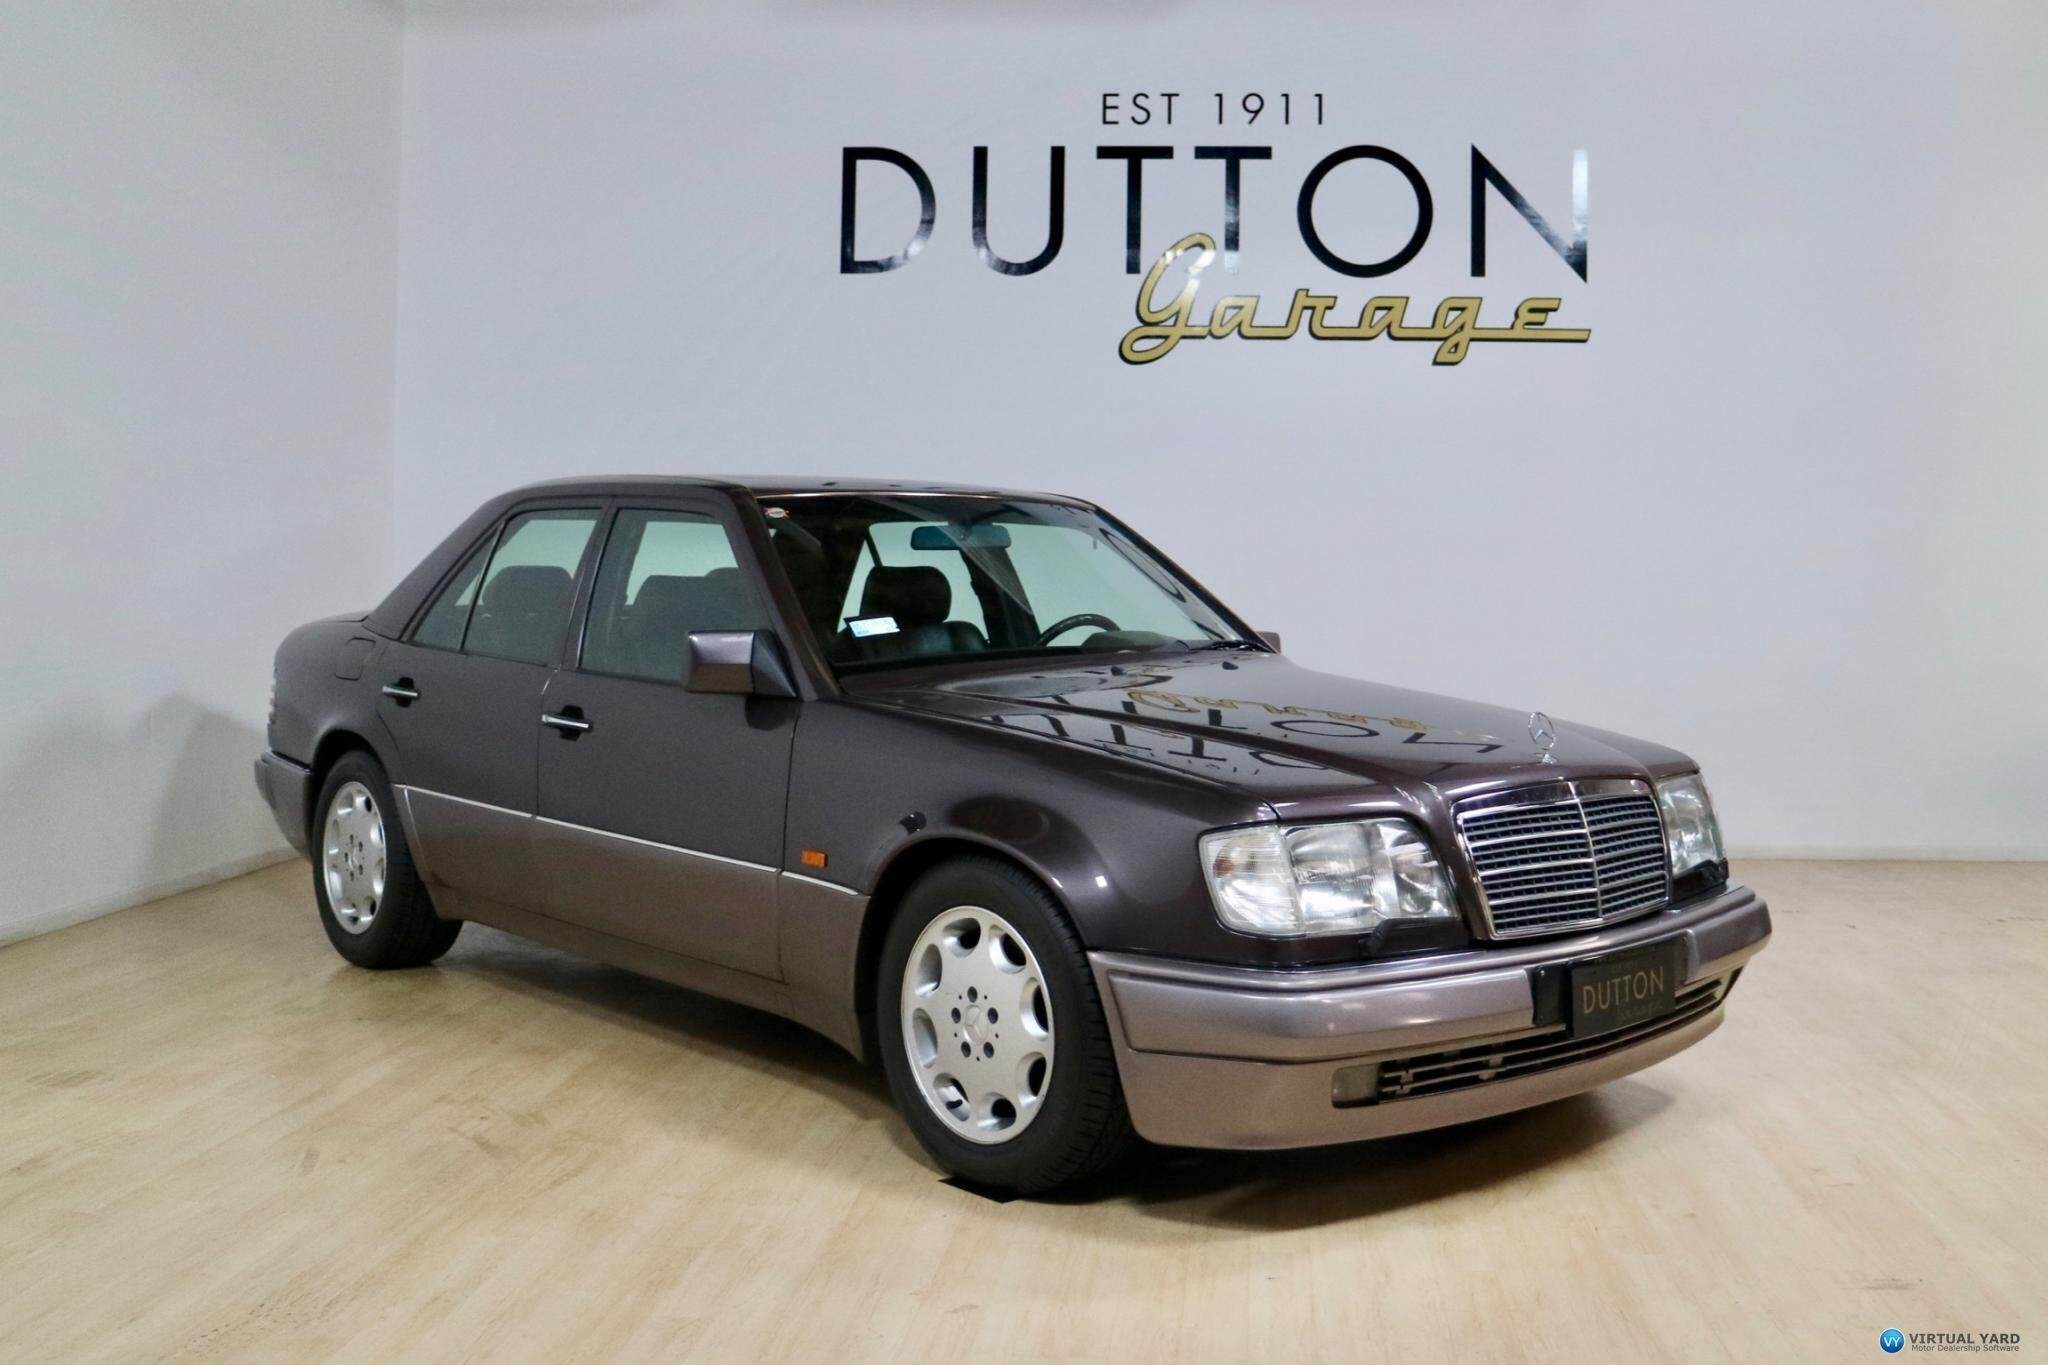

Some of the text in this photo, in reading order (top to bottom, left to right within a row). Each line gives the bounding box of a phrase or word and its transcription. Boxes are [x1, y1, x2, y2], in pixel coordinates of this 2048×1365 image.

[1101, 92, 1328, 126] EST 1911
[839, 143, 1589, 284] DUTTON
[1118, 232, 1593, 367] Garage
[1582, 966, 1665, 1014] DUTTON
